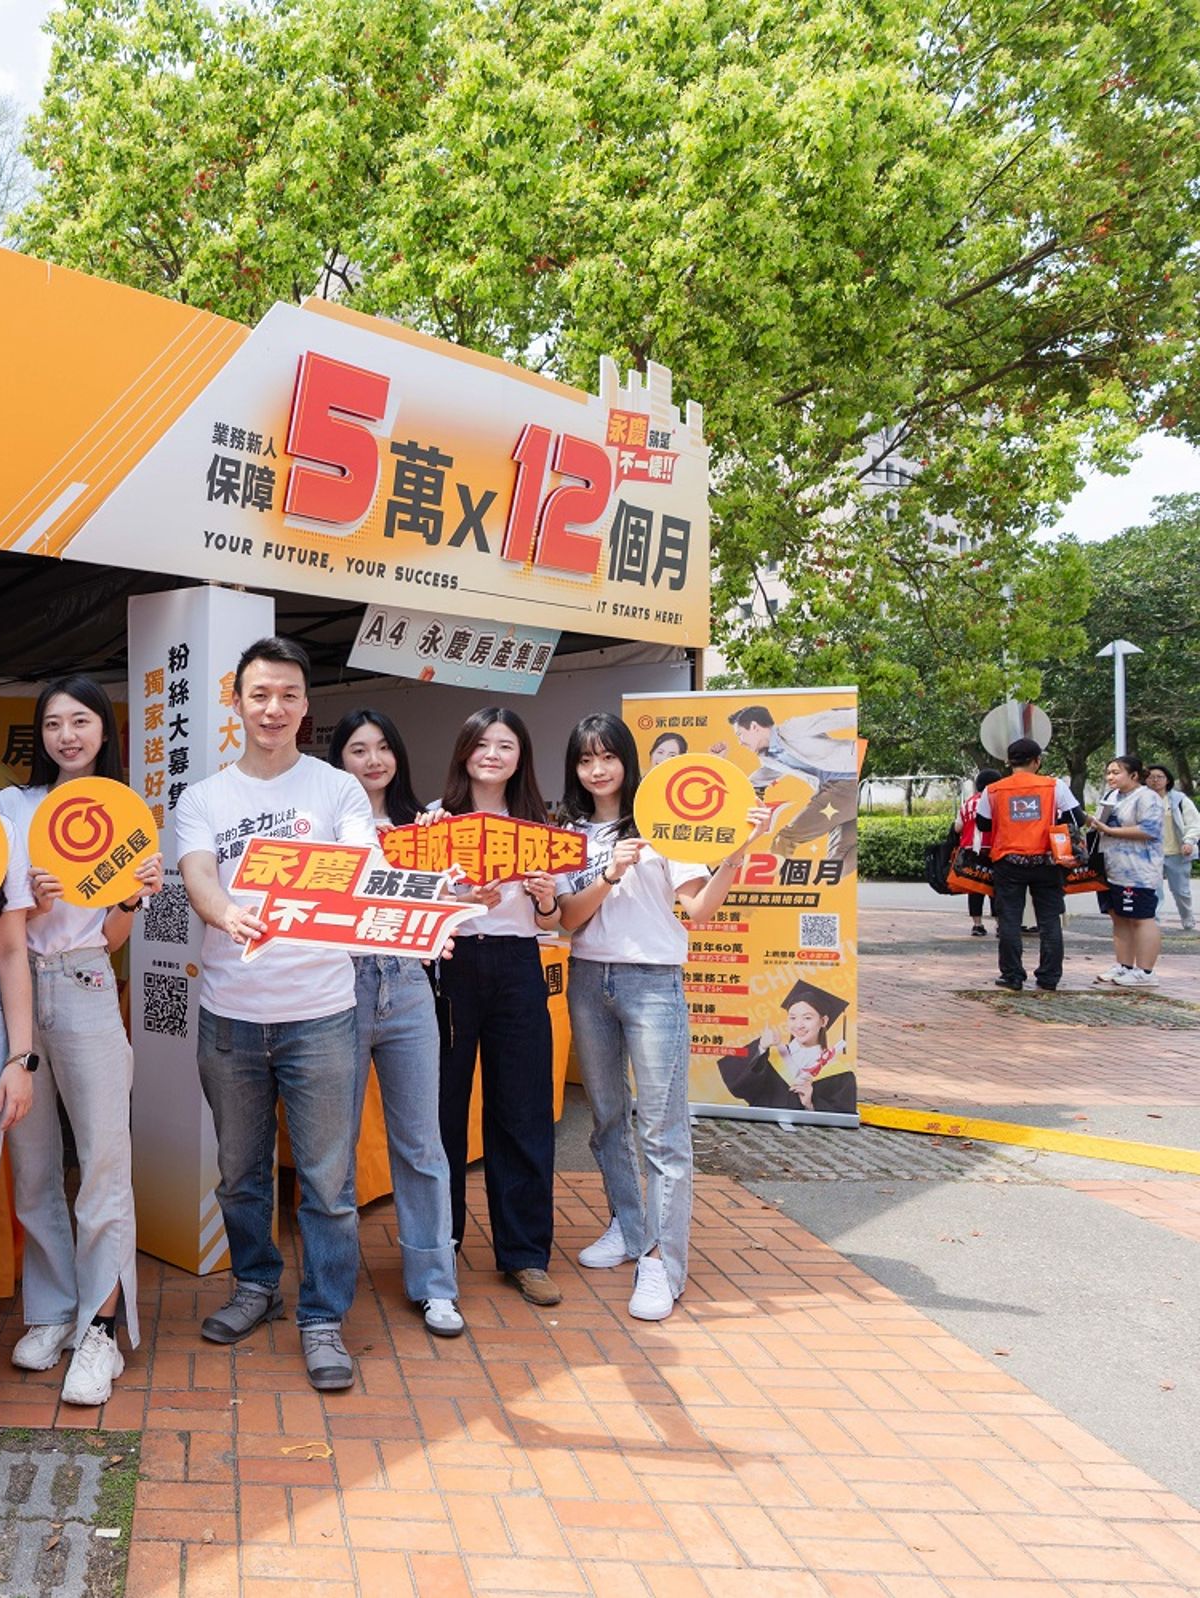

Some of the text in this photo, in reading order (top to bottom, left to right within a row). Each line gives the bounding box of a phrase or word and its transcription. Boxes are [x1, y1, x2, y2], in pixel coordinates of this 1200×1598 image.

[211, 422, 277, 460] 業務新人
[204, 530, 459, 591] YOUR FUTURE, YOUR SUCCESS
[596, 601, 683, 626] IT STARTS HERE!
[365, 614, 550, 673] A4 永慶房產集團
[655, 714, 709, 729] 永慶房屋
[1012, 800, 1038, 812] 104
[383, 814, 584, 884] 先誠實再成交
[651, 823, 737, 845] 永慶房屋
[75, 828, 152, 900] 永慶房屋
[268, 898, 439, 948] 不一樣!!
